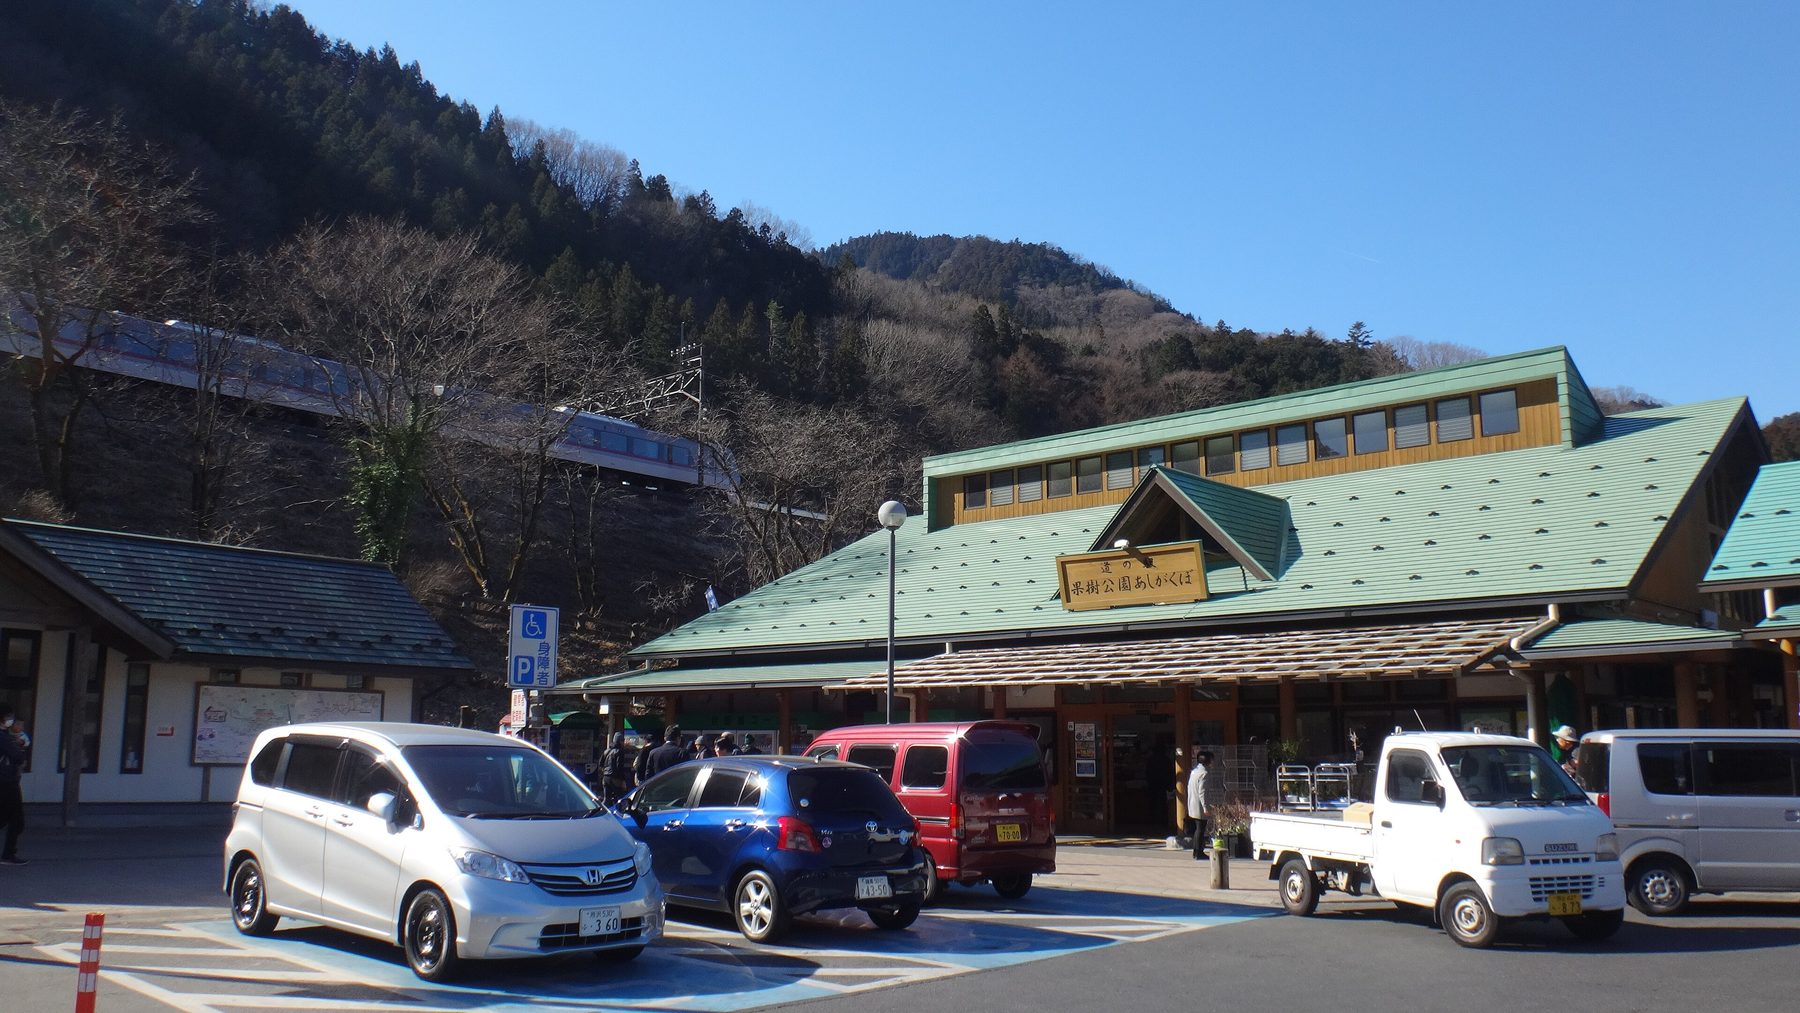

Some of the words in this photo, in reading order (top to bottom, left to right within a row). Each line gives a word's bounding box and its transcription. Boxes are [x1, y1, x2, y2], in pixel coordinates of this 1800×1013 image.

[1071, 569, 1194, 596] 果樹公園あしがくぼ
[517, 657, 531, 682] P
[537, 641, 551, 685] 身障者
[1544, 843, 1578, 852] SUZUKI
